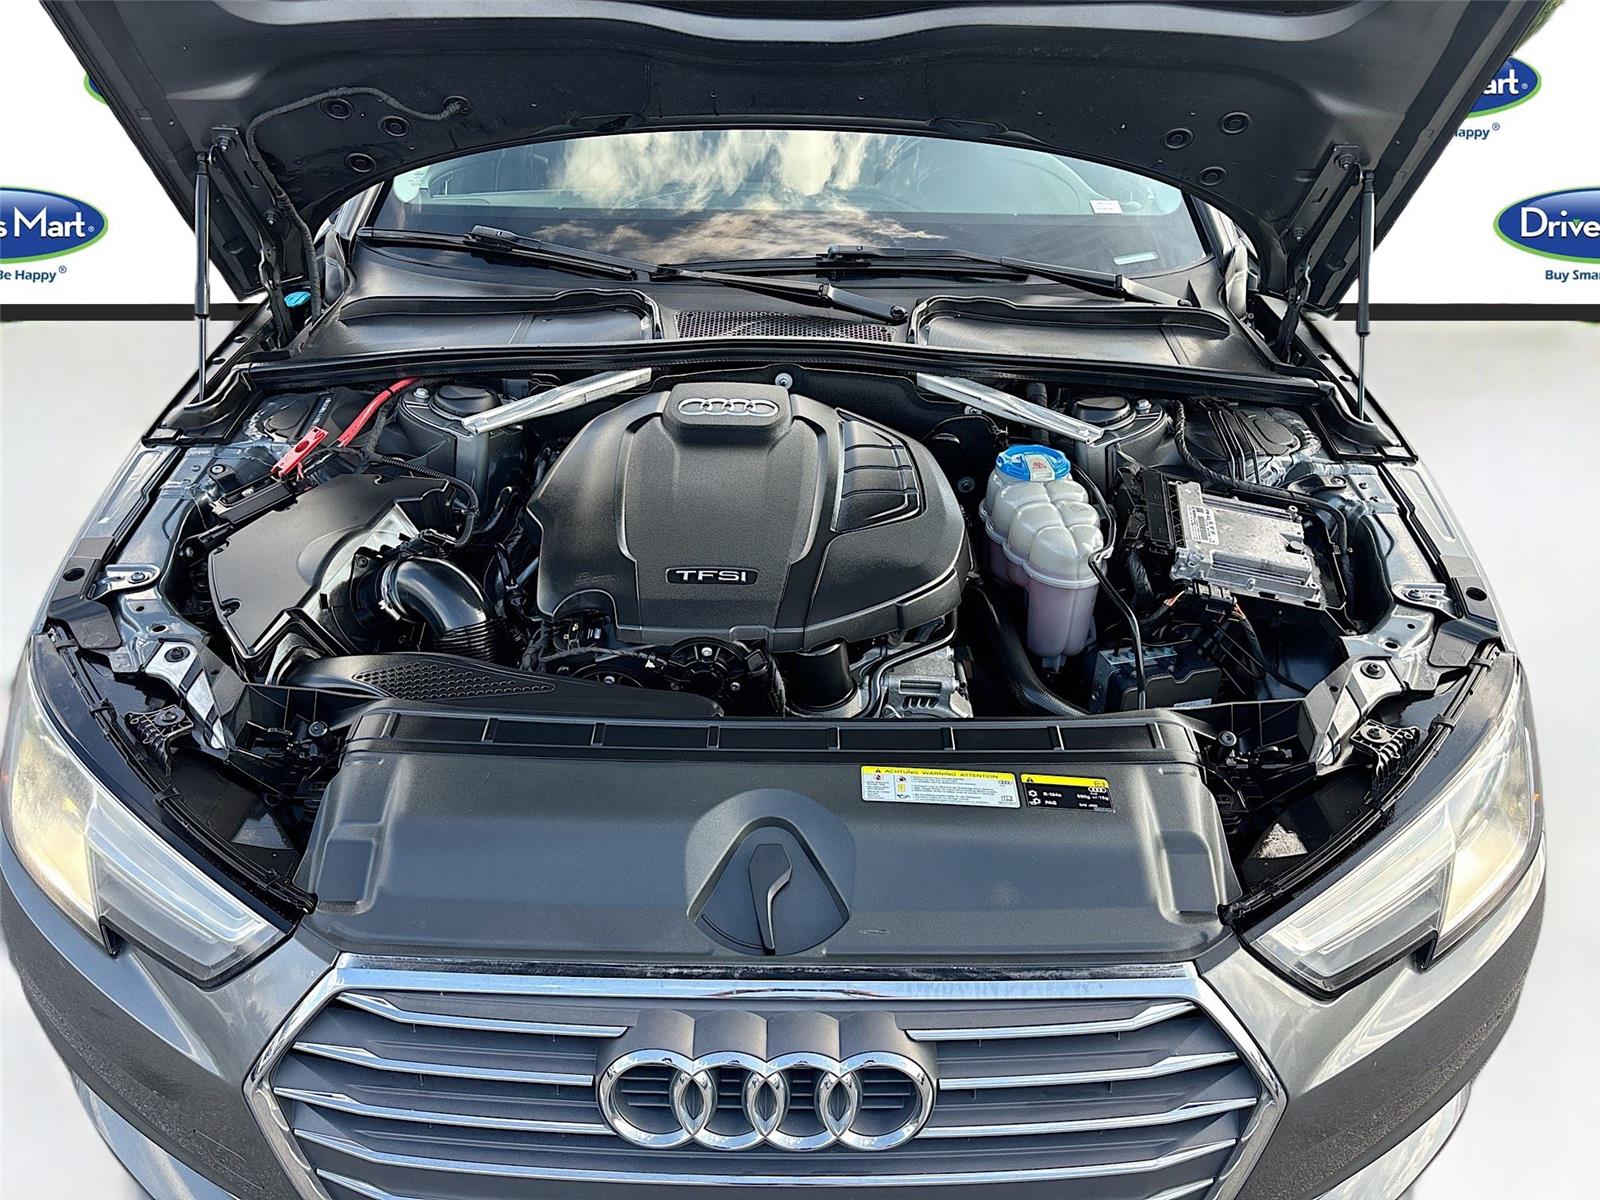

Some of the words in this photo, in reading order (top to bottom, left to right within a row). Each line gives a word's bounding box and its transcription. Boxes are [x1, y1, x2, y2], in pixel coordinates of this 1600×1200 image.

[1483, 69, 1519, 94] art
[1454, 129, 1490, 140] appy
[14, 207, 86, 237] Mart
[15, 270, 57, 283] Happy
[1545, 270, 1569, 283] Buy
[1572, 270, 1600, 280] Sma
[675, 570, 746, 582] TFSI
